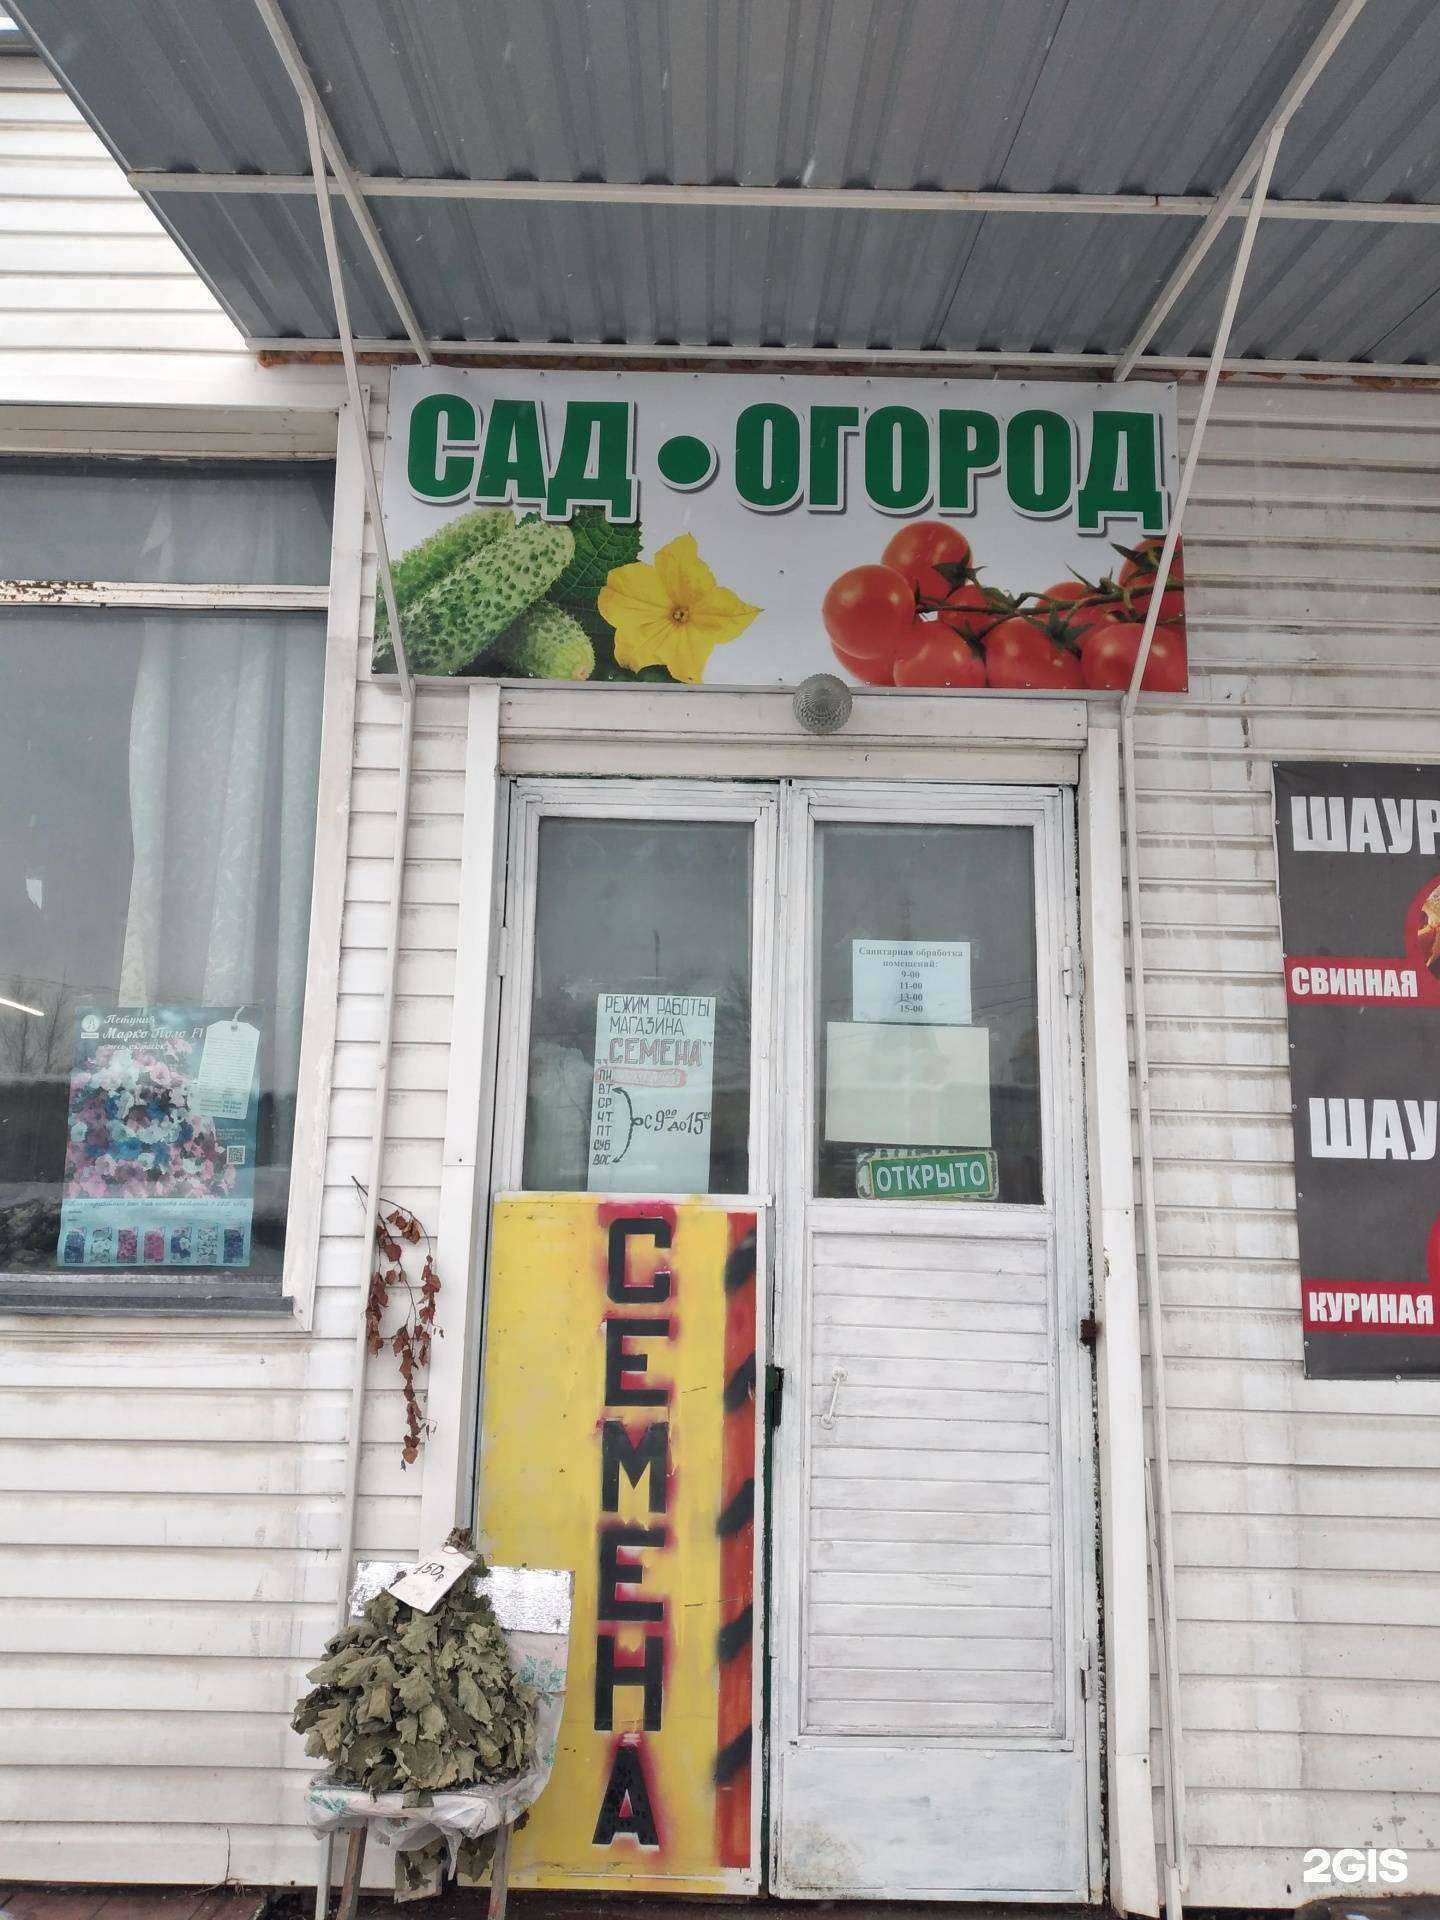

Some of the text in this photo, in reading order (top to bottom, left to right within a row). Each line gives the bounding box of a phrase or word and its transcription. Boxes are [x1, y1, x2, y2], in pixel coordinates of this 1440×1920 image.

[407, 393, 1164, 530] САД ОГОРОД
[1291, 796, 1440, 854] ШАУР
[858, 947, 964, 958] Санитарная обработка
[883, 960, 939, 968] помещений:
[901, 970, 920, 979] 9-00
[900, 982, 923, 990] 11-00
[1291, 966, 1418, 998] СВИННАЯ
[900, 993, 923, 1002] 13-00
[605, 996, 711, 1017] РЕЖИМ РАБОТЫ
[900, 1005, 923, 1013] 15-00
[104, 1014, 156, 1027] Петуния
[609, 1016, 685, 1036] МАГАЗИНА
[102, 1027, 150, 1041] Марко
[599, 1069, 613, 1081] ПН
[599, 1083, 614, 1095] ВТ
[598, 1097, 612, 1109] СР
[597, 1111, 614, 1122] ЧТ
[596, 1125, 613, 1137] ПТ
[1309, 1098, 1438, 1160] ШАУ
[593, 1139, 611, 1151] СУБ
[592, 1154, 610, 1166] ВОС
[876, 1161, 986, 1192] ОТКРЫТО
[1309, 1292, 1434, 1324] КУРИНАЯ
[592, 1217, 676, 1852] СЕМЕНА
